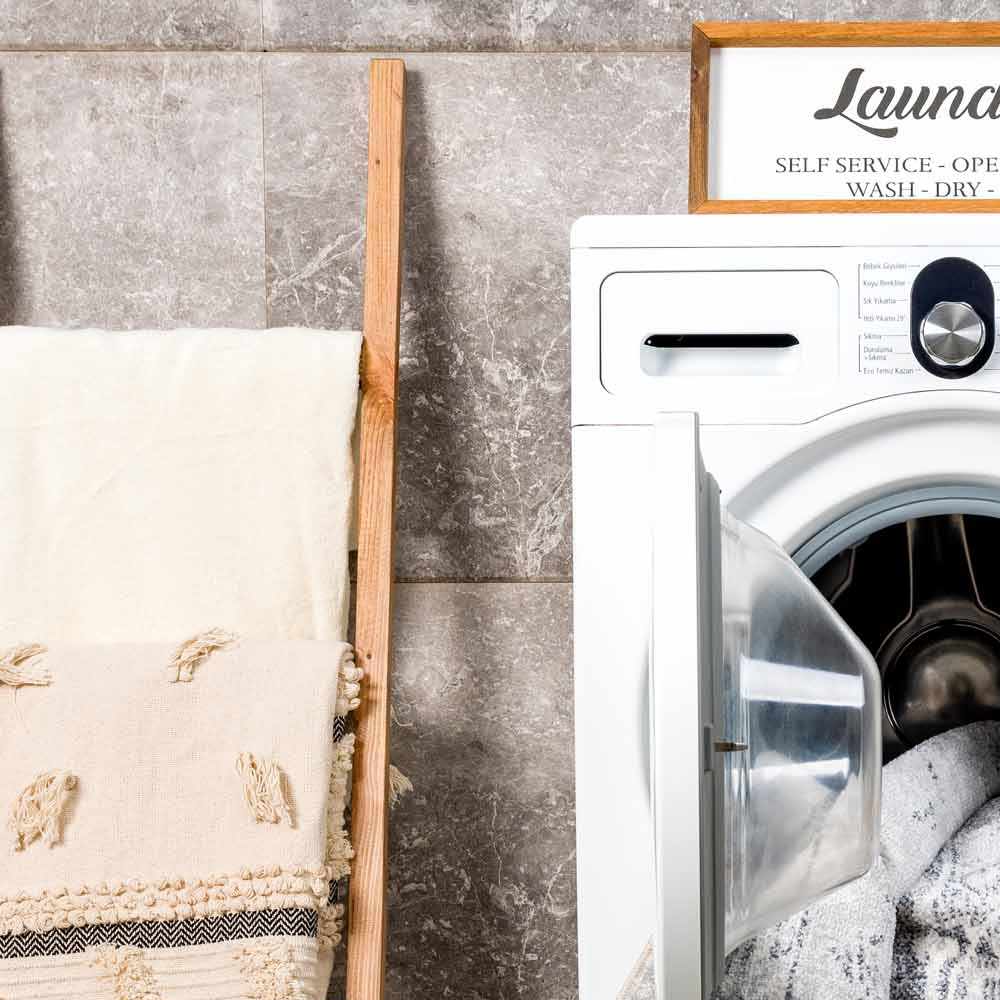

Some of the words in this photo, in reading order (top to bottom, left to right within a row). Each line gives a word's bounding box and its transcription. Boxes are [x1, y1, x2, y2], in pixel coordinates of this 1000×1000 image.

[775, 157, 830, 173] SELF
[835, 157, 932, 173] SERVICE
[846, 181, 915, 198] WASH
[935, 181, 981, 198] DRY
